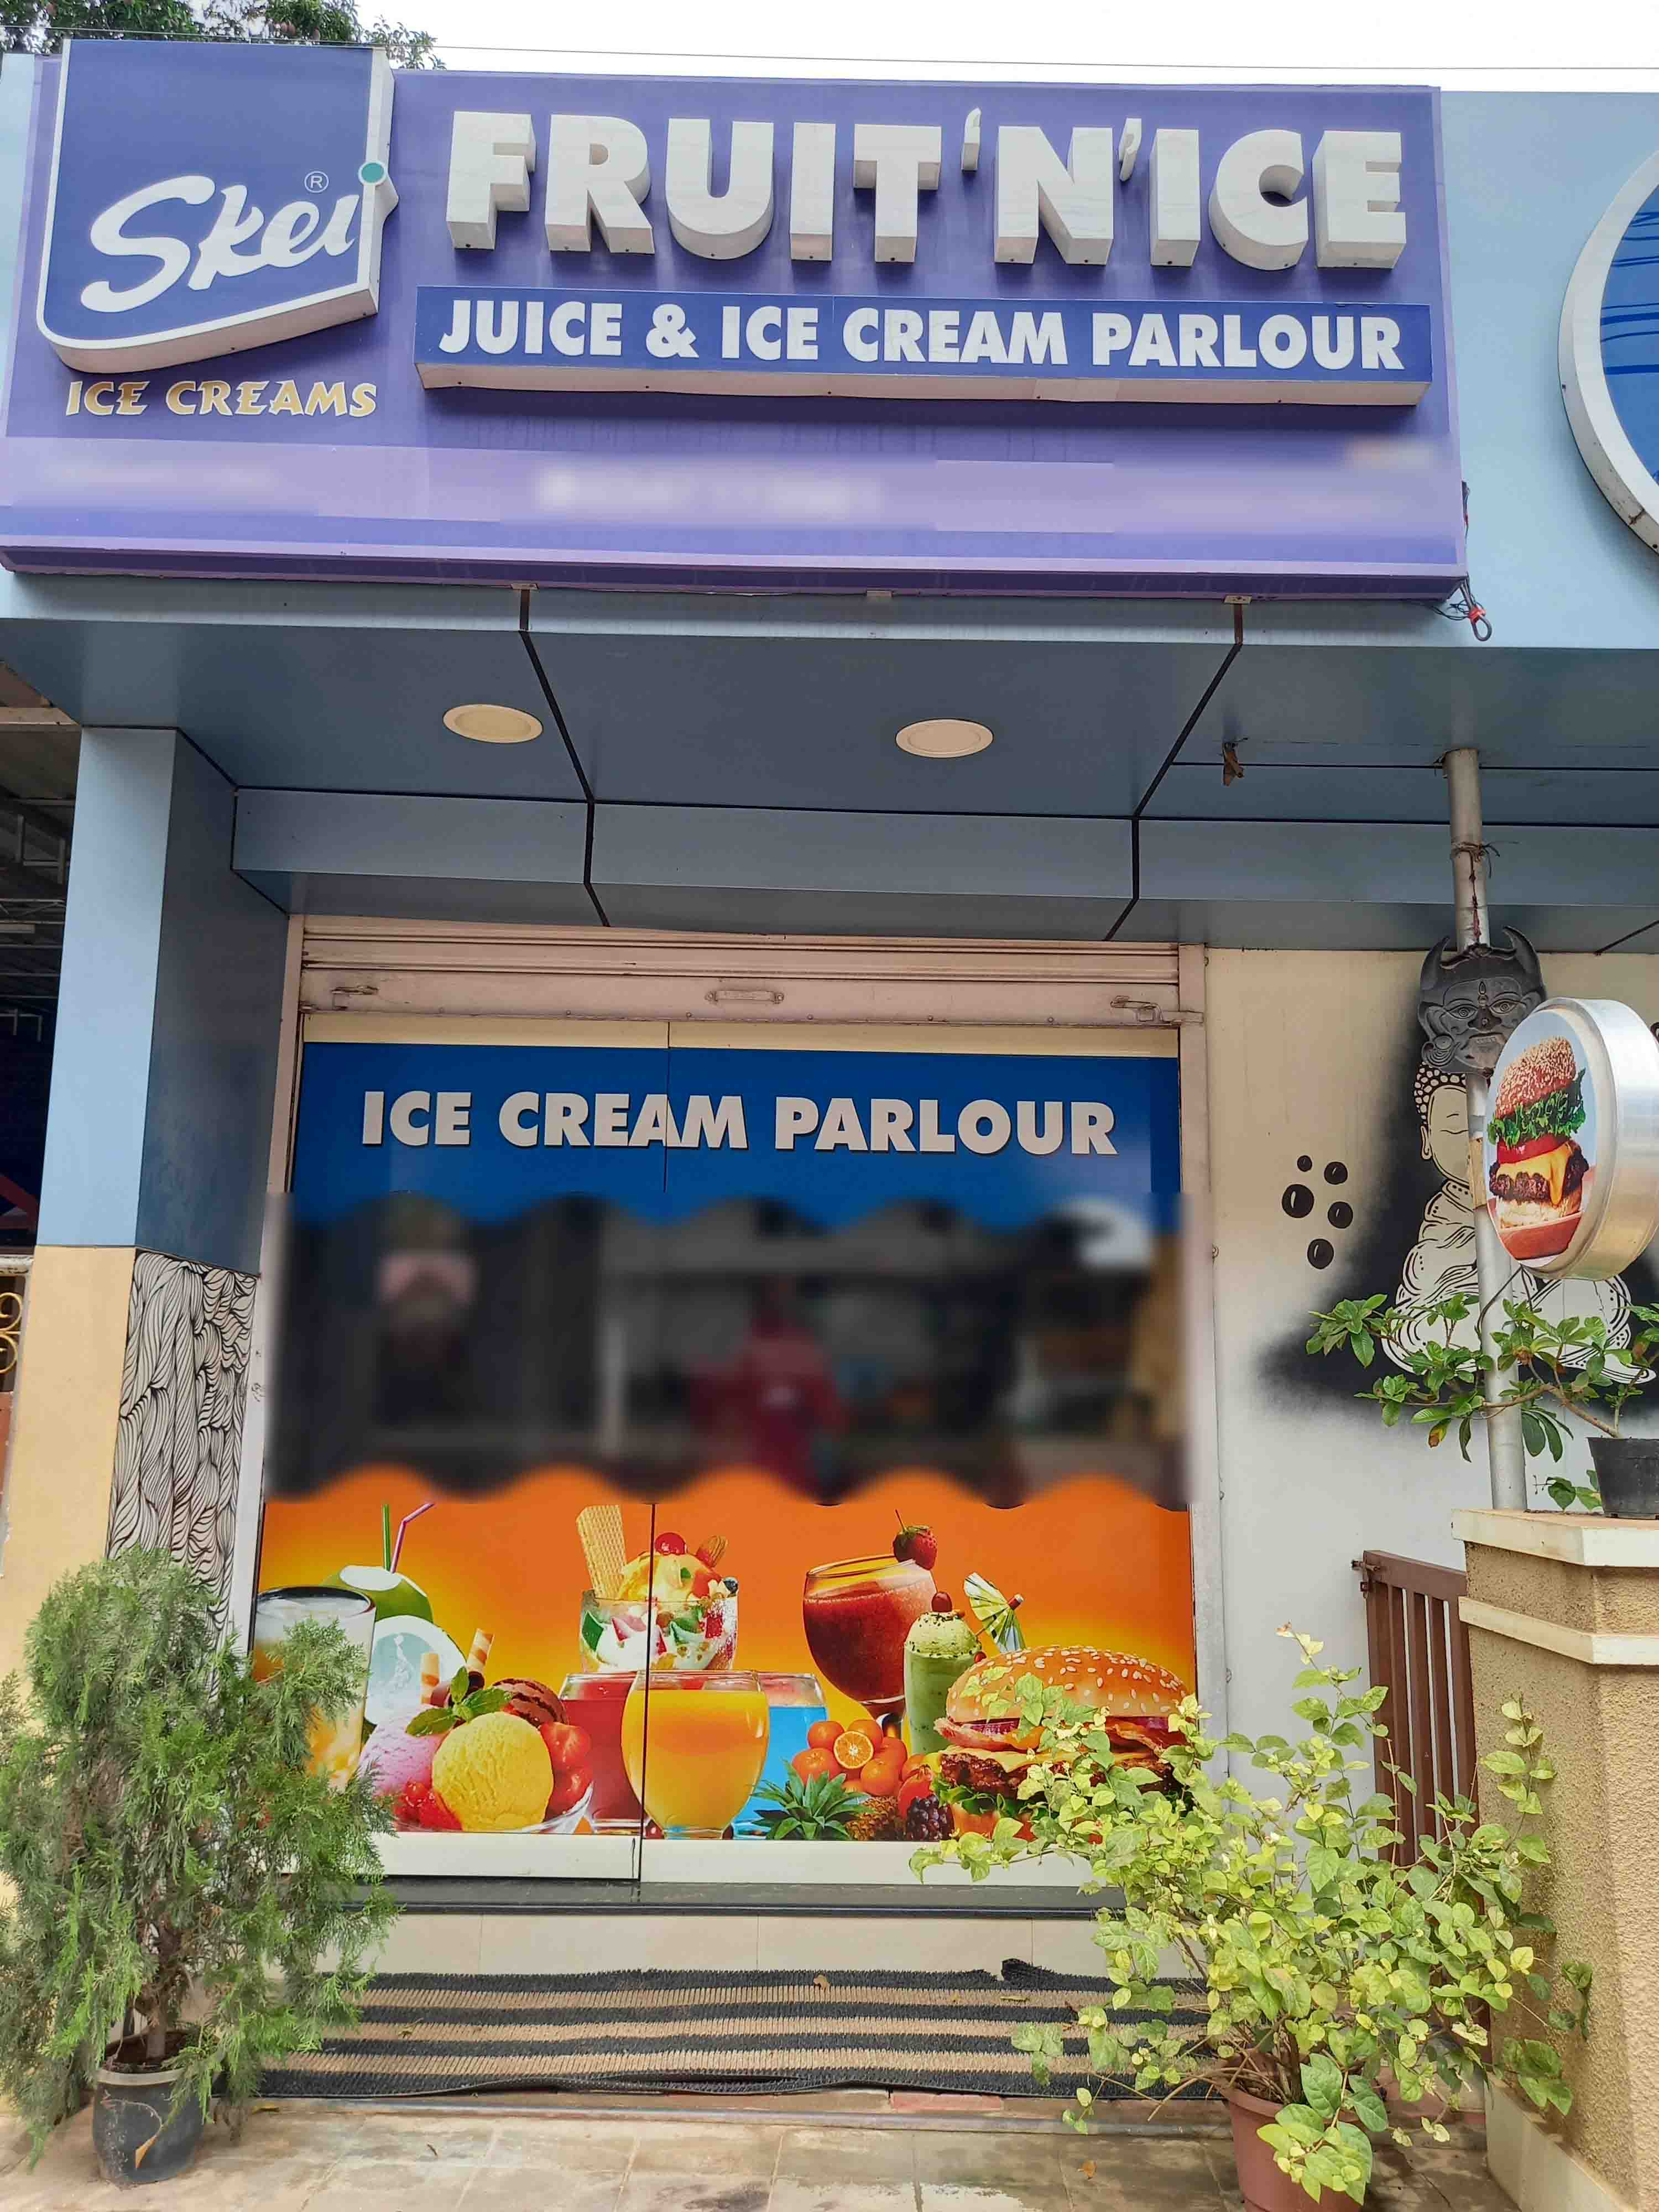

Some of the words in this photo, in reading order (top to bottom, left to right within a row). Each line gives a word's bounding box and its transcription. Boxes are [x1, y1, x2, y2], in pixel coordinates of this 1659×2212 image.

[439, 300, 623, 357] JUICE
[645, 304, 700, 358] &
[721, 306, 818, 362] ICE
[842, 307, 1068, 366] CREAM
[1092, 312, 1405, 371] PARLOUR
[65, 380, 150, 416] ICE
[165, 379, 378, 418] CREAMS
[362, 1090, 472, 1146] ICE
[498, 1091, 749, 1150] CREAM
[775, 1097, 1119, 1156] PARLOUR
